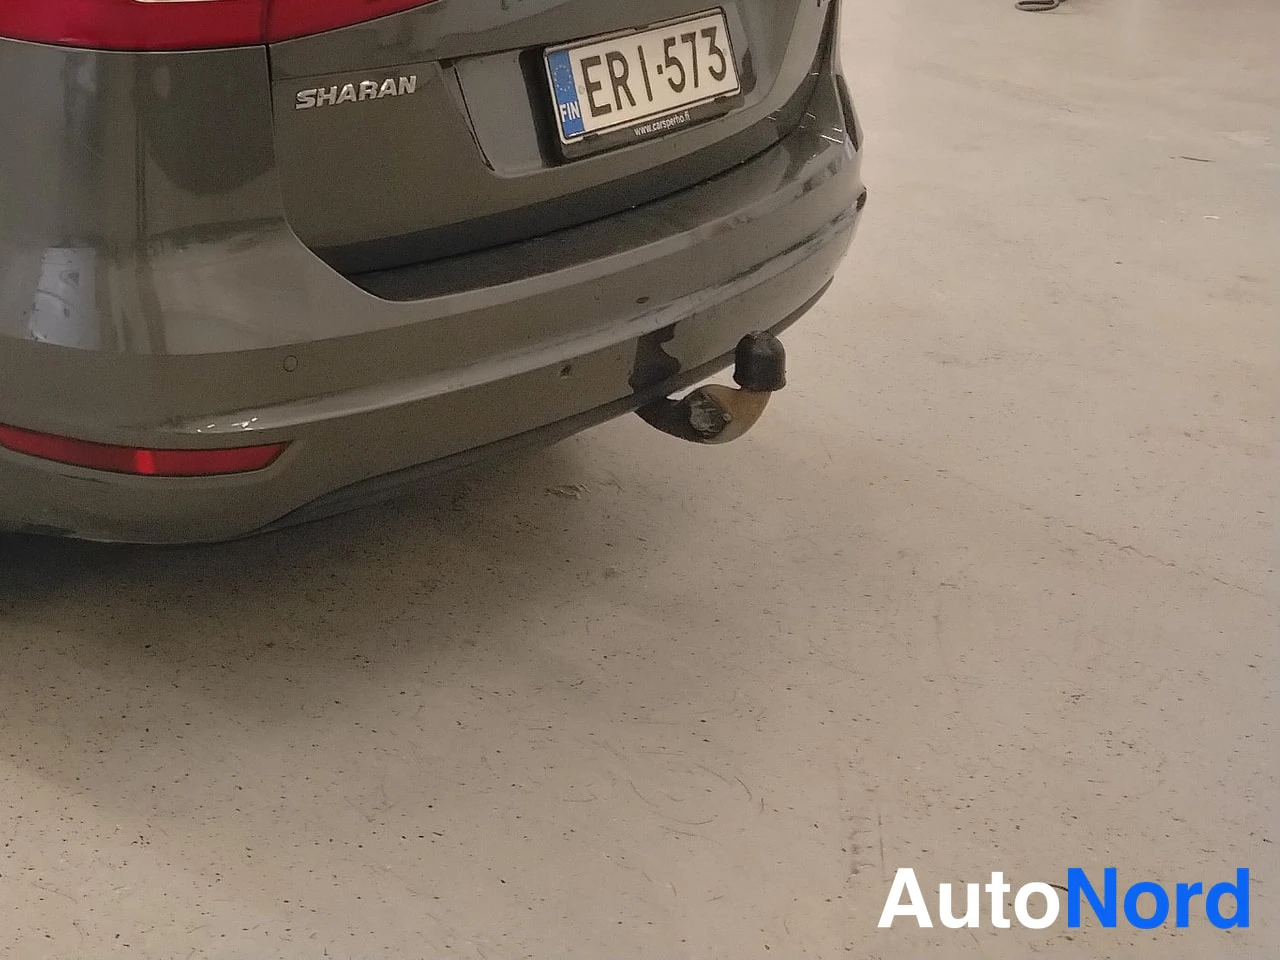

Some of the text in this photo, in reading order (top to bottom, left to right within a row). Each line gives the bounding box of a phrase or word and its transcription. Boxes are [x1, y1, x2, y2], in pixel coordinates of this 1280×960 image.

[580, 26, 727, 117] ERI-573
[295, 75, 417, 110] SHARAN
[560, 100, 581, 123] FIN
[633, 110, 692, 137] www.carsperho.fi
